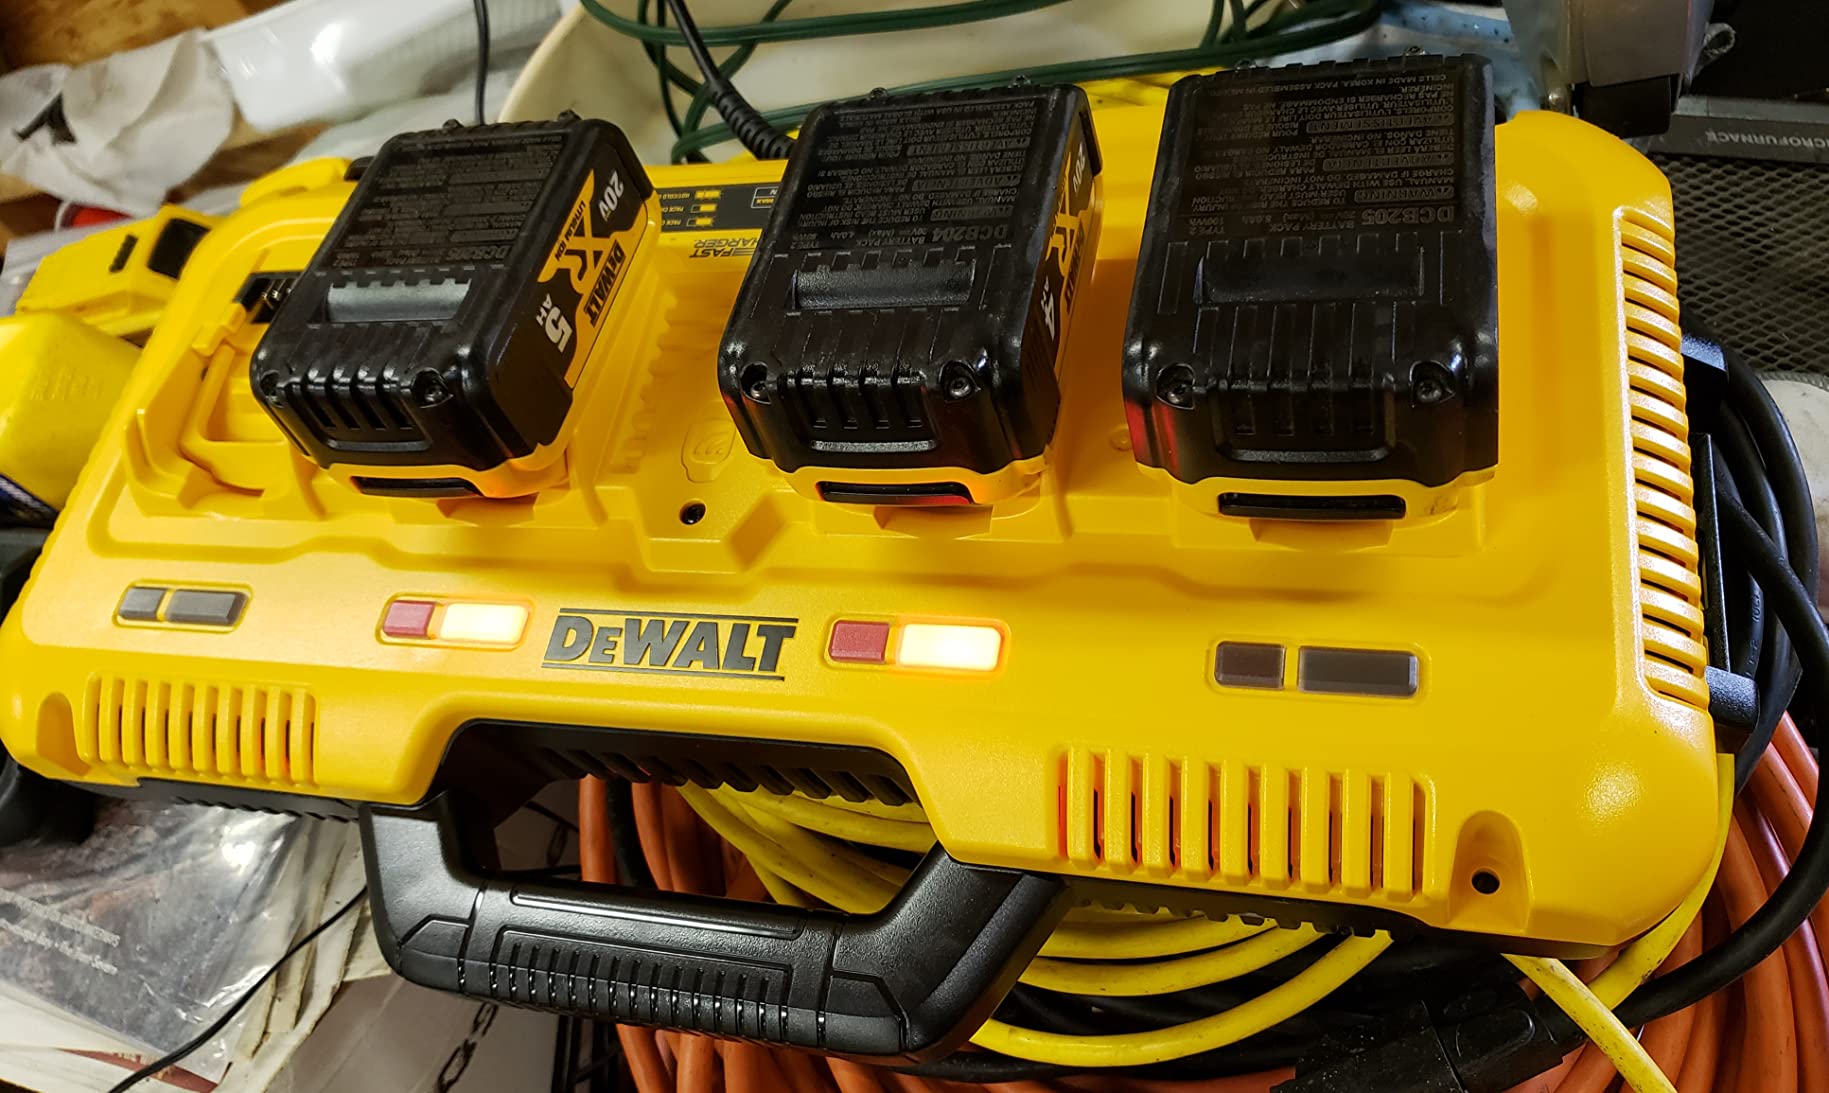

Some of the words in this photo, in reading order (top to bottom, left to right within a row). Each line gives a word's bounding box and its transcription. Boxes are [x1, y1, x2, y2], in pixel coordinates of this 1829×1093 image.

[1313, 80, 1338, 88] PACK
[1375, 77, 1385, 85] IN
[1387, 75, 1416, 84] MADE
[1303, 174, 1323, 182] NOT
[1326, 173, 1340, 181] DO
[1352, 179, 1379, 188] WITH
[598, 170, 625, 222] 20V
[1358, 186, 1432, 202] WARNING
[564, 200, 587, 241] LITHIUM
[1361, 204, 1454, 226] DCB205
[929, 222, 1009, 243] DCB204
[1269, 222, 1299, 232] PACK
[694, 237, 758, 249] HARGER
[554, 242, 567, 262] ION
[689, 247, 736, 258] FAST
[585, 241, 626, 328] DEWALT
[545, 306, 573, 353] 5
[544, 615, 797, 673] DEWALT
